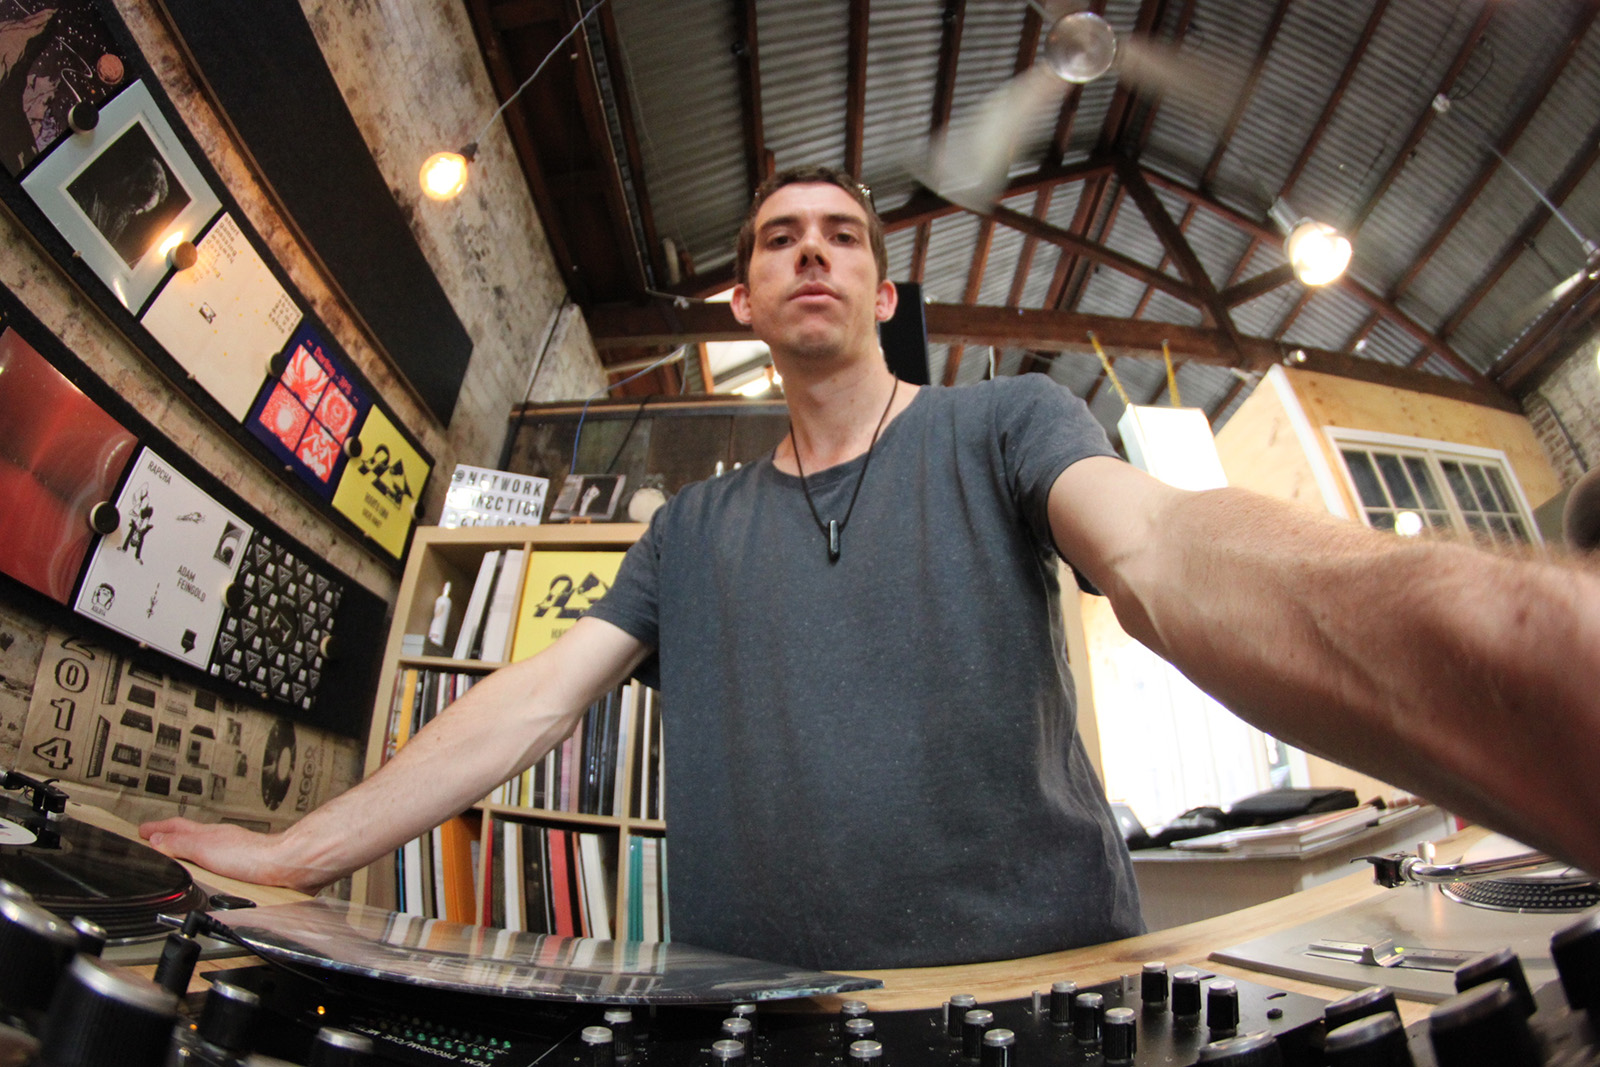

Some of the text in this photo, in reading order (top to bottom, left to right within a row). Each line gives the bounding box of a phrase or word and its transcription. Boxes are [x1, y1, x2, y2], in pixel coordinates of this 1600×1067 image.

[147, 461, 172, 486] RAPCHA
[177, 565, 196, 581] ADAM
[176, 579, 207, 603] FEINGOLD
